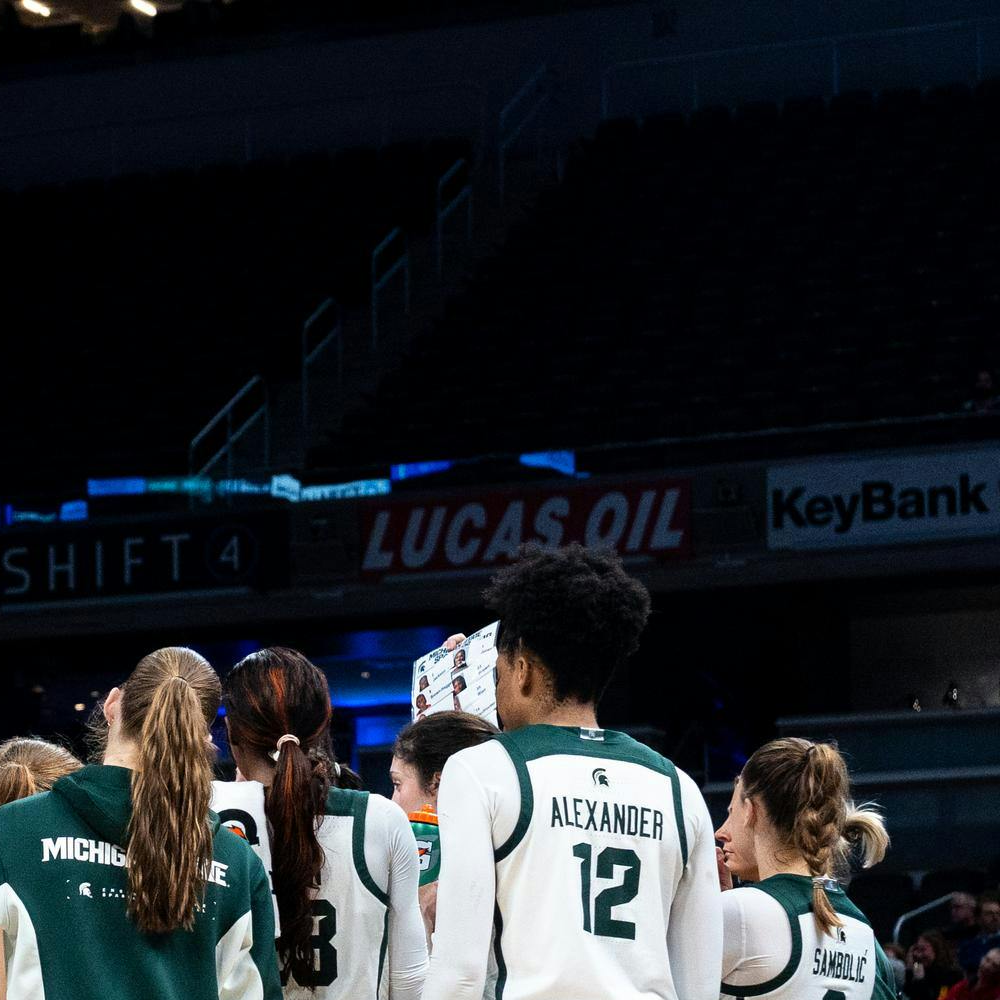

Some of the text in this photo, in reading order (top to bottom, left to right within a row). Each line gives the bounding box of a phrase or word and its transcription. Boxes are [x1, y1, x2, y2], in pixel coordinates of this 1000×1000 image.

[362, 487, 686, 571] LUCAS OIL
[773, 474, 988, 533] KeyBank
[1, 531, 241, 595] SHIFT 4
[550, 796, 664, 841] ALEXANDER
[41, 836, 129, 868] MICHIG
[572, 842, 641, 940] 12
[812, 948, 868, 984] SAMBOLIĆ
